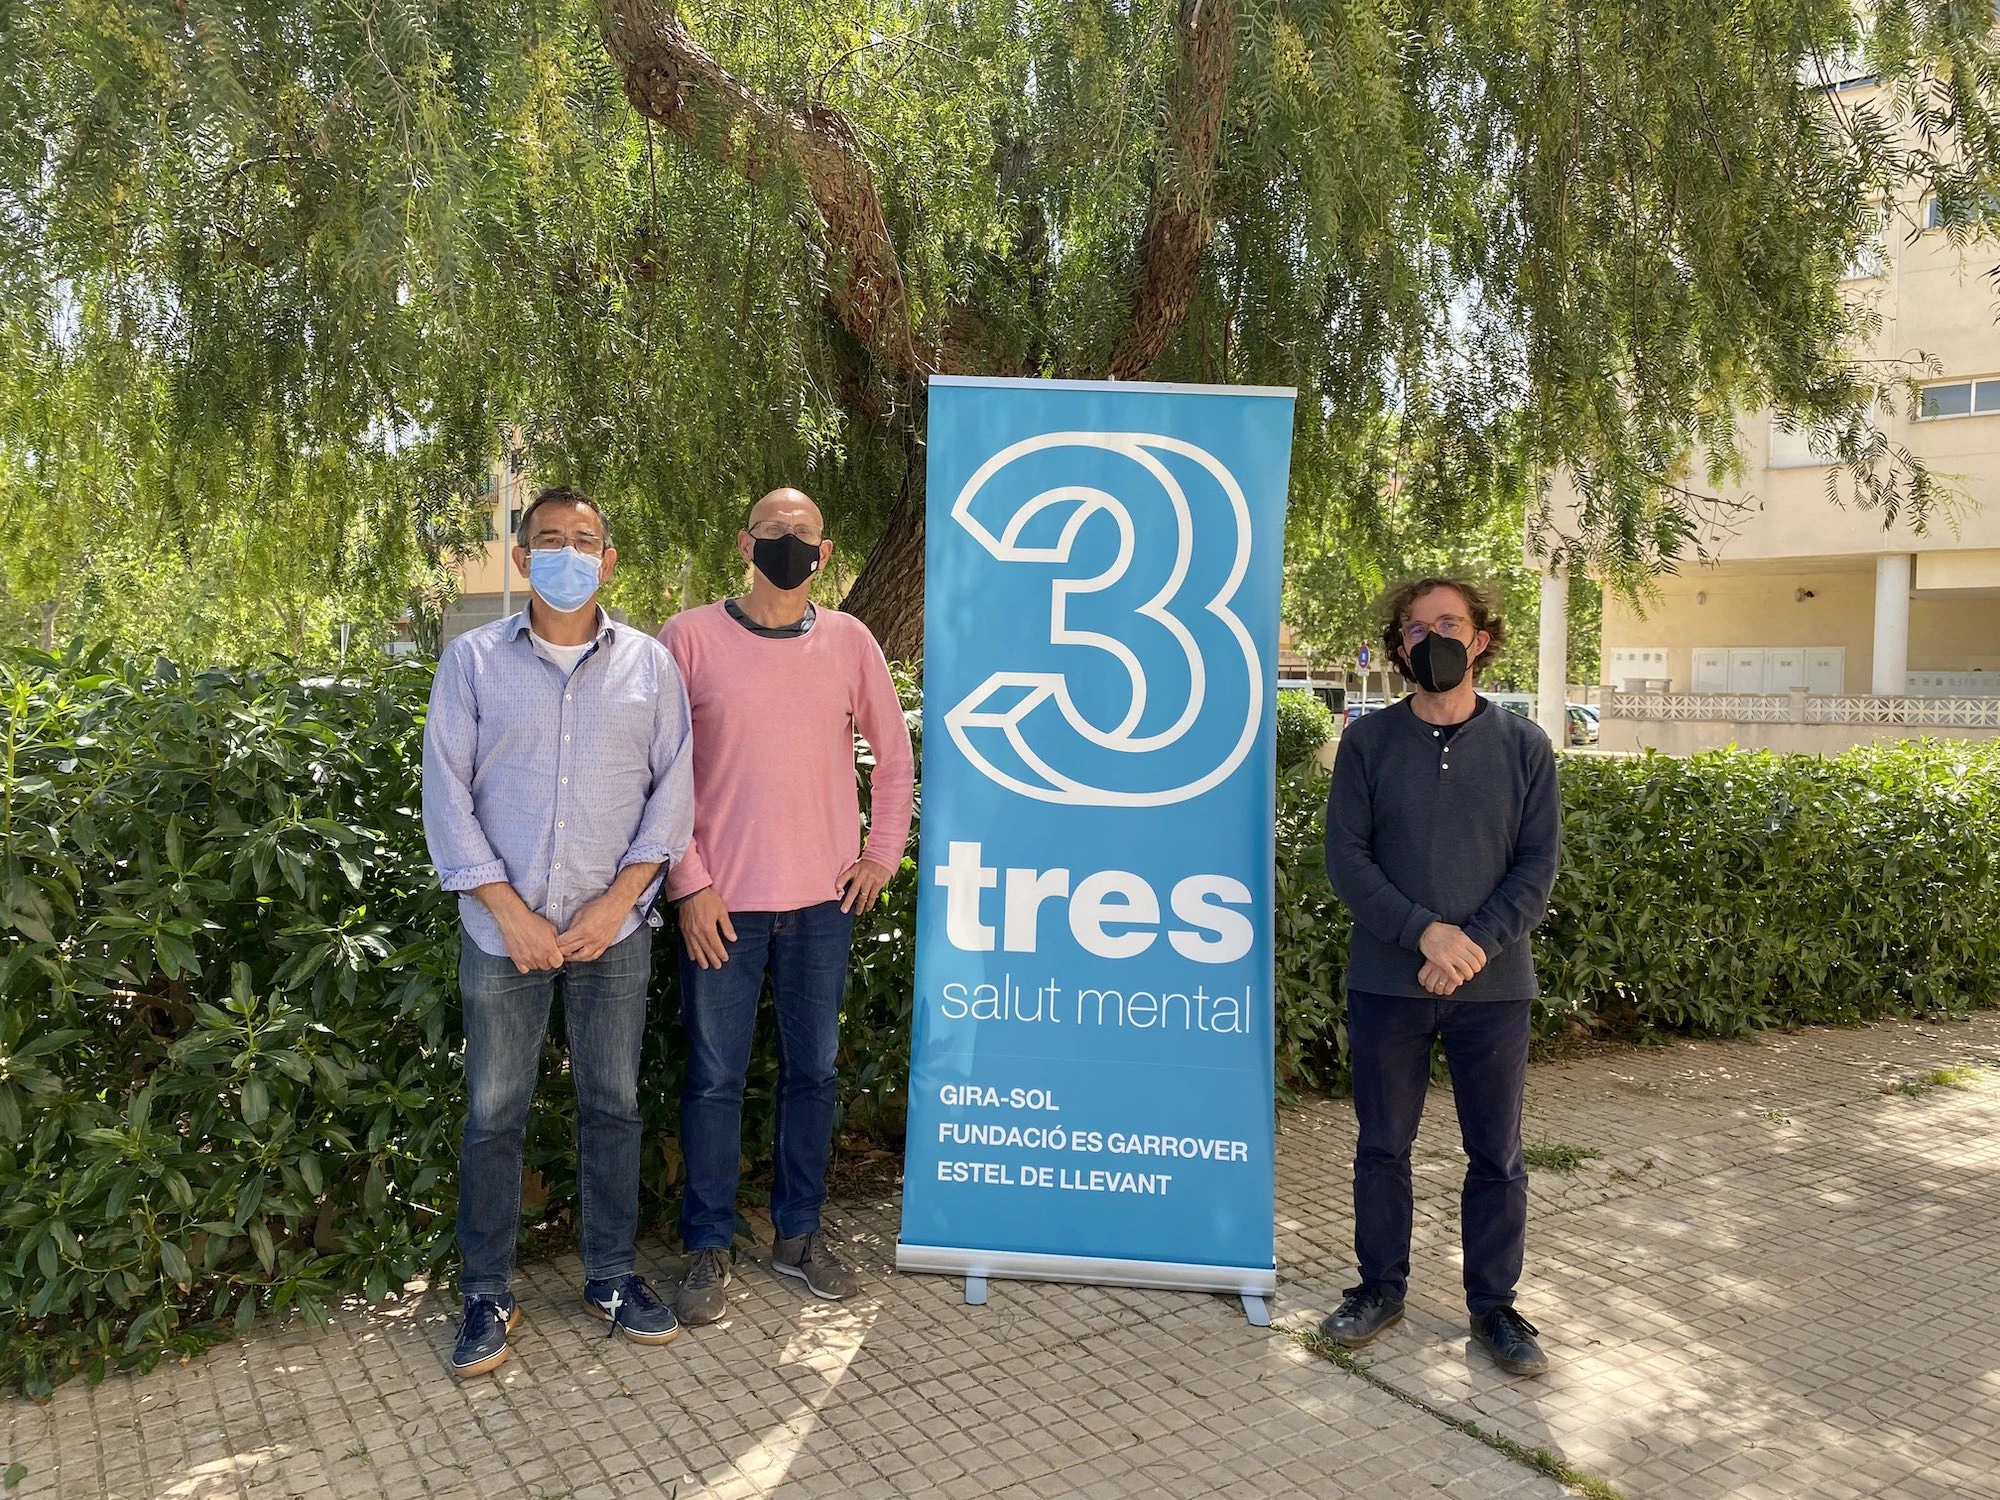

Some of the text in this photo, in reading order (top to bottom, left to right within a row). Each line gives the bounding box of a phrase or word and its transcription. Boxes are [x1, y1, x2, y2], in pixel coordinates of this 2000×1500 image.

[944, 432, 1263, 807] 3
[935, 841, 1254, 963] tres
[941, 974, 1250, 1034] salut mental
[939, 1084, 1060, 1111] GIRA-SOL
[938, 1123, 1248, 1162] FUNDACIÓ ES GARROVER
[937, 1161, 1172, 1195] ESTEL DE LLEVANT
